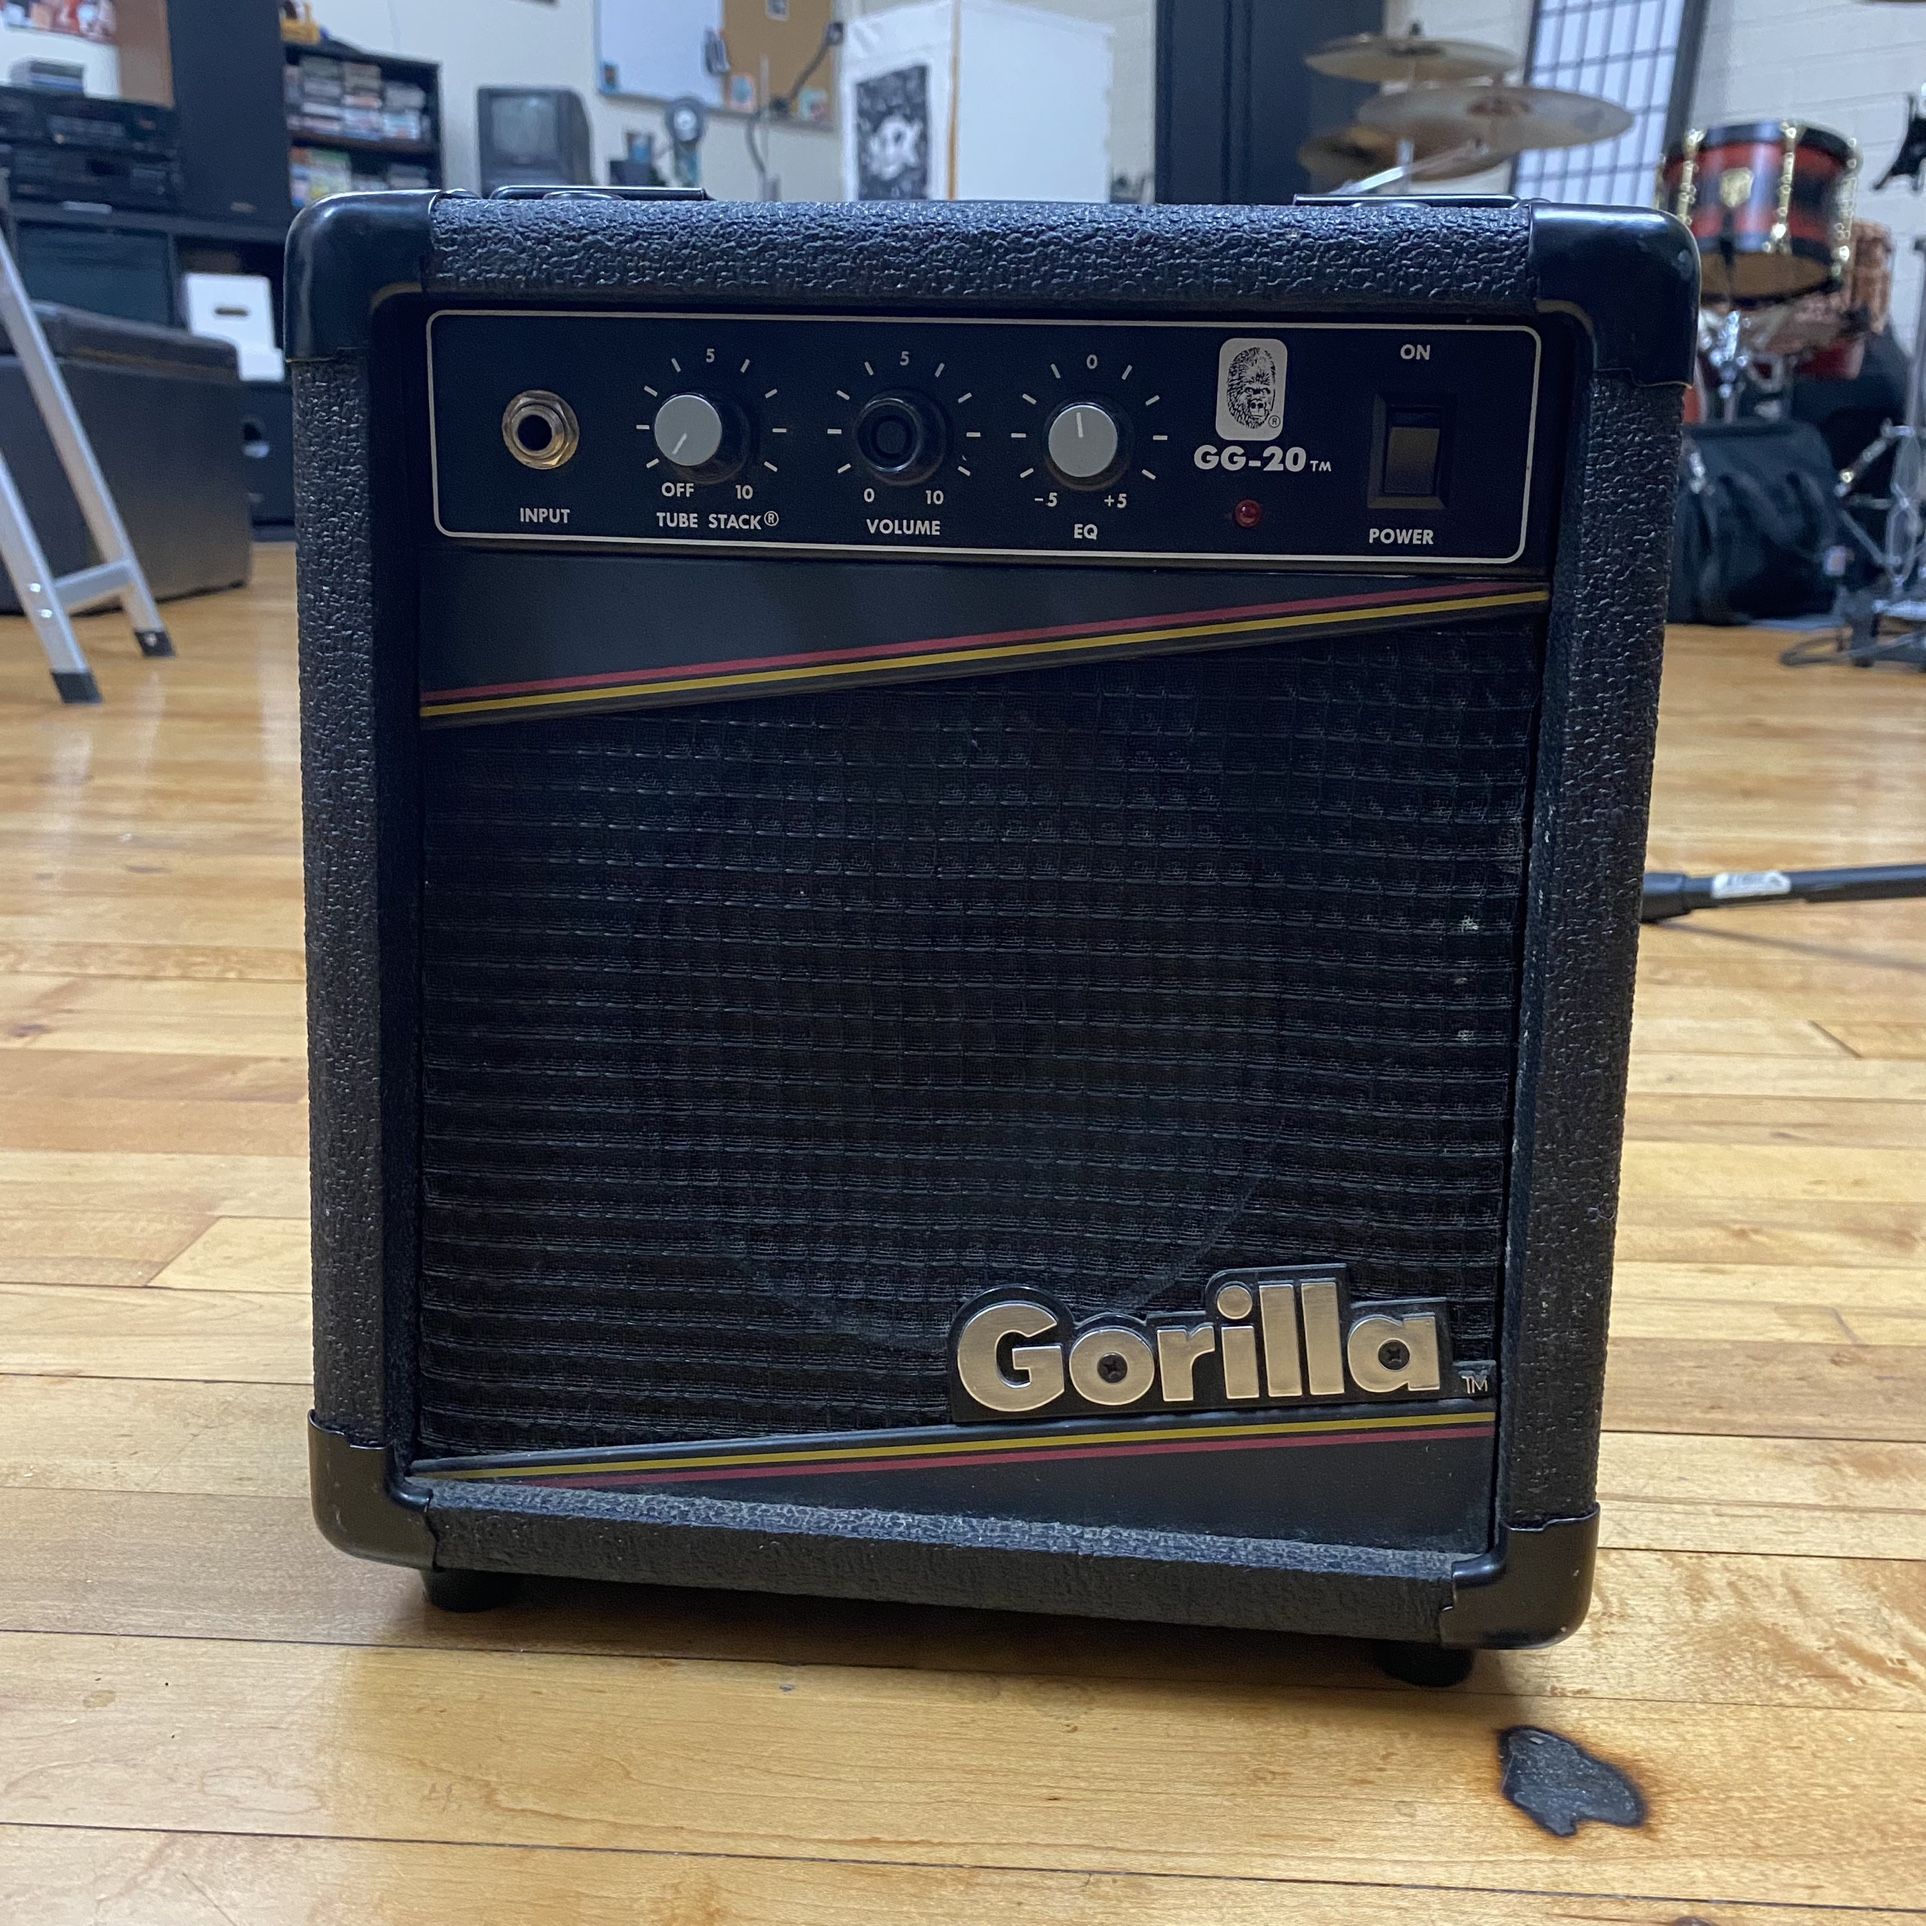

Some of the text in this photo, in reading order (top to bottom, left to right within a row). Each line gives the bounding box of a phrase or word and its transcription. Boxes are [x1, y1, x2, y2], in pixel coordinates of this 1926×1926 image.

[705, 348, 715, 364] 5
[900, 351, 910, 367] 5
[1400, 344, 1431, 360] ON
[1087, 354, 1098, 370] 0
[1193, 445, 1307, 473] GG-20
[661, 481, 695, 498] OFF
[735, 484, 754, 500] 10
[863, 487, 875, 503] 0
[925, 490, 944, 506] 10
[1104, 493, 1127, 509] +5
[519, 507, 570, 524] INPUT
[656, 512, 698, 528] TUBE
[866, 518, 941, 536] VOLUME
[1073, 524, 1098, 541] EQ
[1368, 528, 1434, 545] POWER
[957, 1277, 1441, 1412] Gorilla
